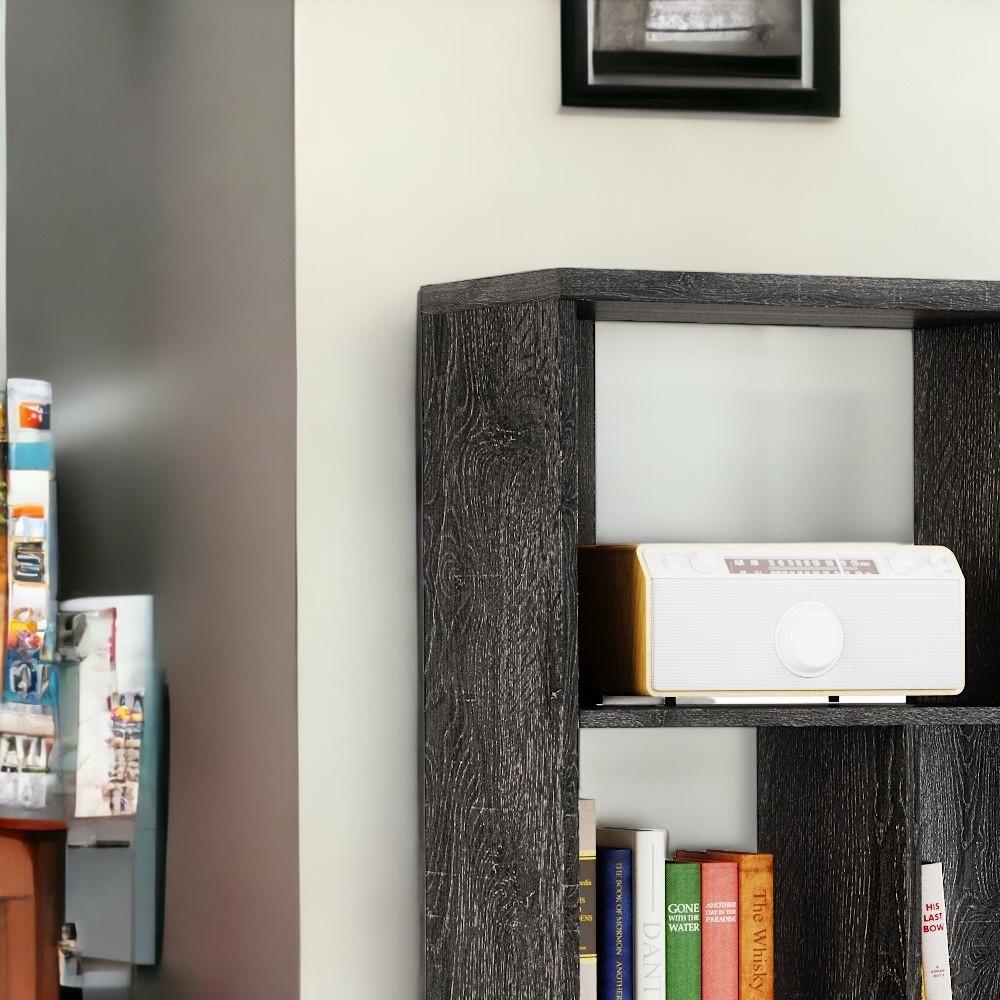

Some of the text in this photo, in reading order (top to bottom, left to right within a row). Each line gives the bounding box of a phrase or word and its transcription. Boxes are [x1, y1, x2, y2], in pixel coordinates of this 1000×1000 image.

[667, 903, 700, 913] GONE
[705, 901, 737, 909] ANOTHER
[753, 890, 767, 922] The
[926, 902, 940, 911] HIS
[923, 912, 943, 922] LAST
[669, 923, 700, 932] WATER
[923, 923, 945, 933] BOW
[750, 928, 767, 992] Whisky
